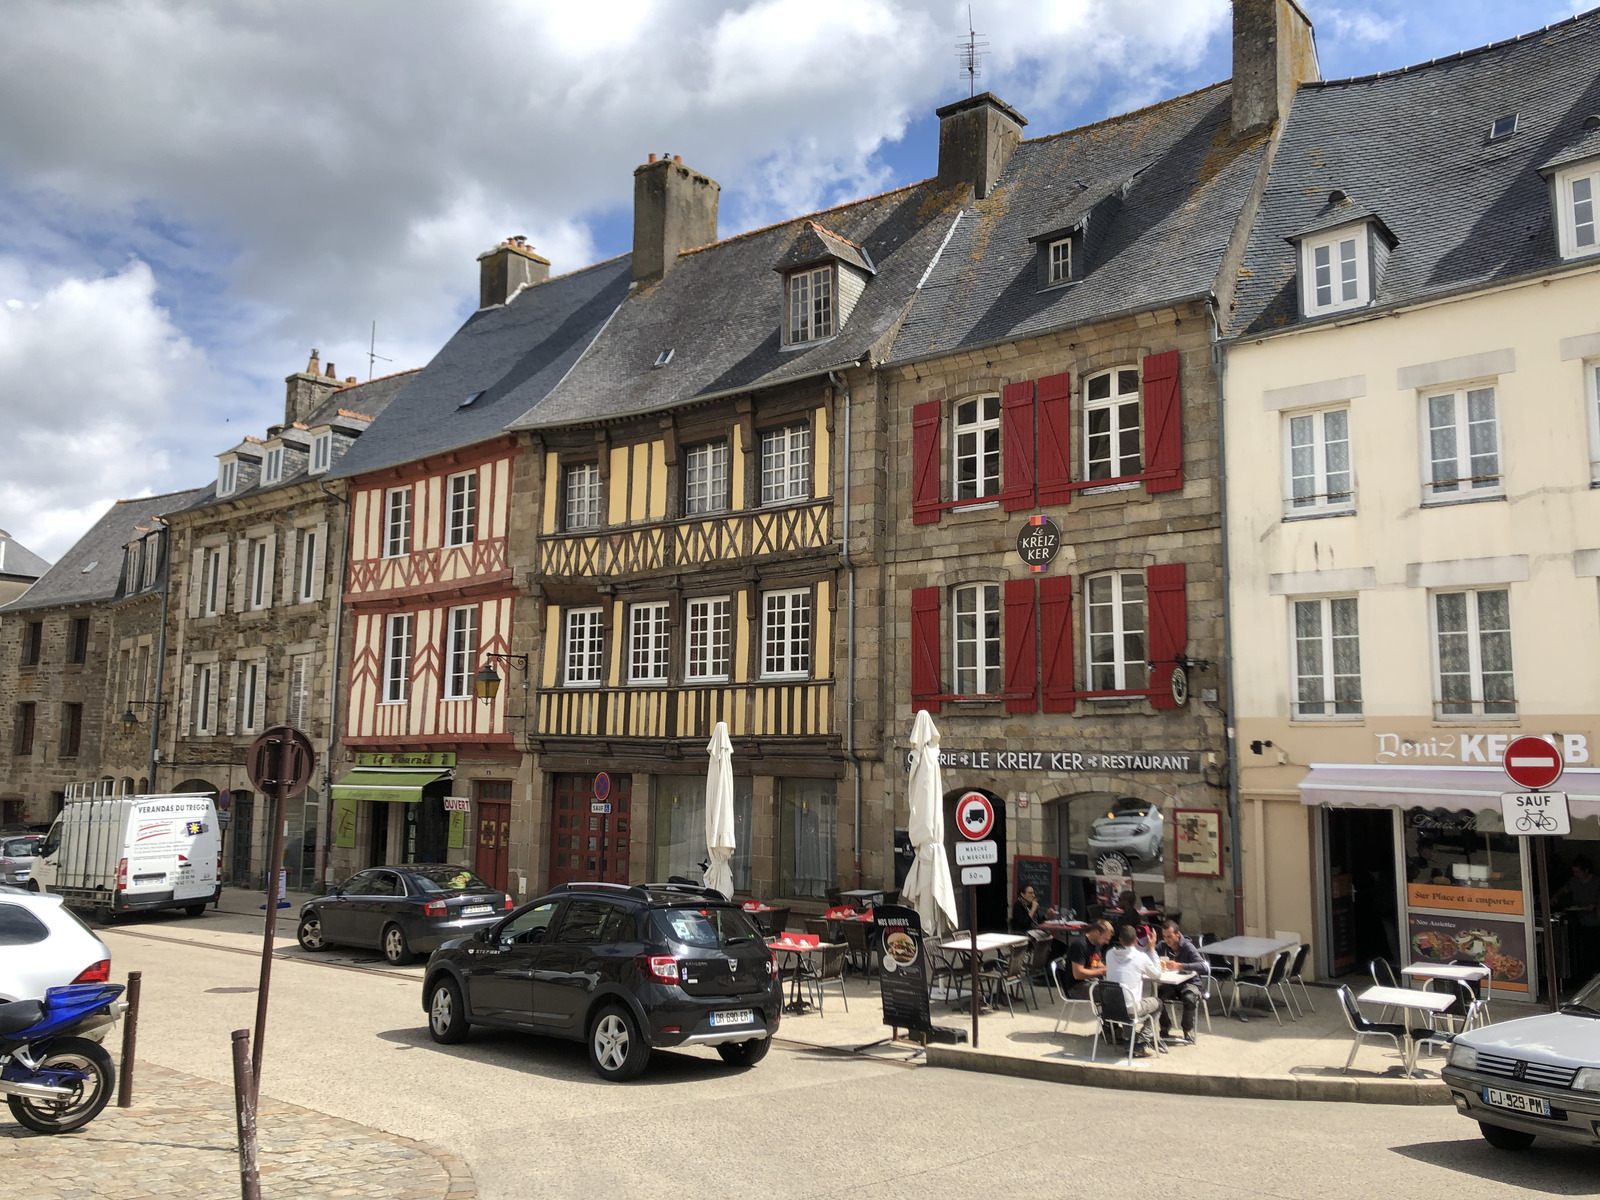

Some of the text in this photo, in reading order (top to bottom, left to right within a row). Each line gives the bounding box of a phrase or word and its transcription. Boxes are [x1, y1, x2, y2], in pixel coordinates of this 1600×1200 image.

[1032, 527, 1044, 536] Le
[1022, 535, 1055, 549] KREIZ
[1027, 547, 1050, 560] KER
[1374, 732, 1590, 764] Deniz KEB
[972, 751, 989, 768] LE
[997, 752, 1042, 769] KREIZ
[1051, 752, 1084, 770] KER
[1101, 755, 1190, 770] RESTAURANT
[444, 799, 470, 811] OUVERT
[1516, 795, 1551, 807] SAUF
[138, 803, 210, 814] VERANDAS DU TREGOR
[1414, 890, 1430, 899] Sur
[1432, 891, 1455, 902] Place
[1475, 897, 1516, 907] emporter
[877, 917, 909, 927] NOS BURGERS
[1429, 920, 1456, 928] Assiettes
